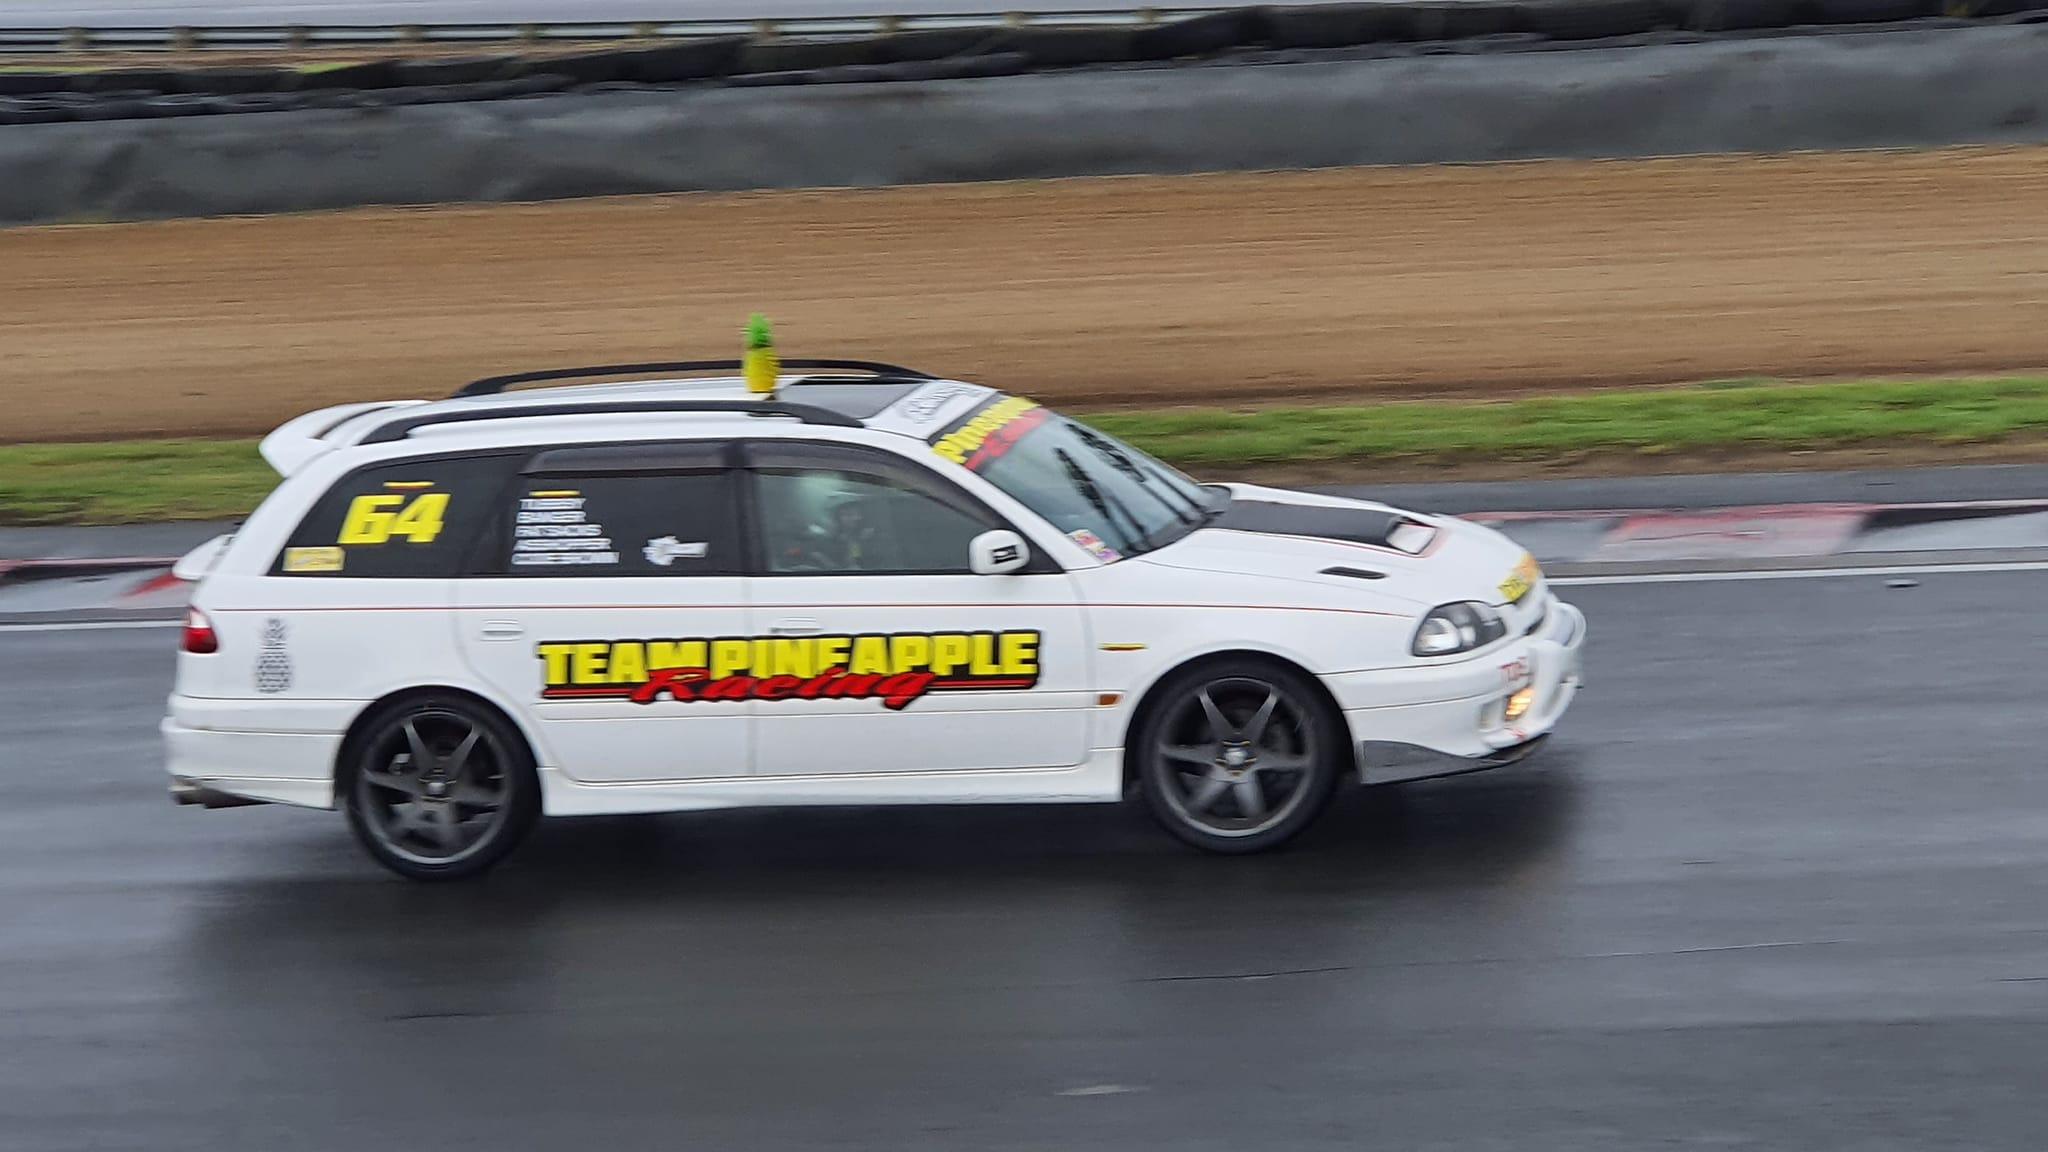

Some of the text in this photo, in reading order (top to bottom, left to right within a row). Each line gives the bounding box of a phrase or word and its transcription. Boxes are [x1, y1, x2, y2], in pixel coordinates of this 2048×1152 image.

[337, 494, 450, 543] 64
[538, 632, 1038, 686] TEAM PINEAPPLE
[630, 666, 937, 710] Racing
